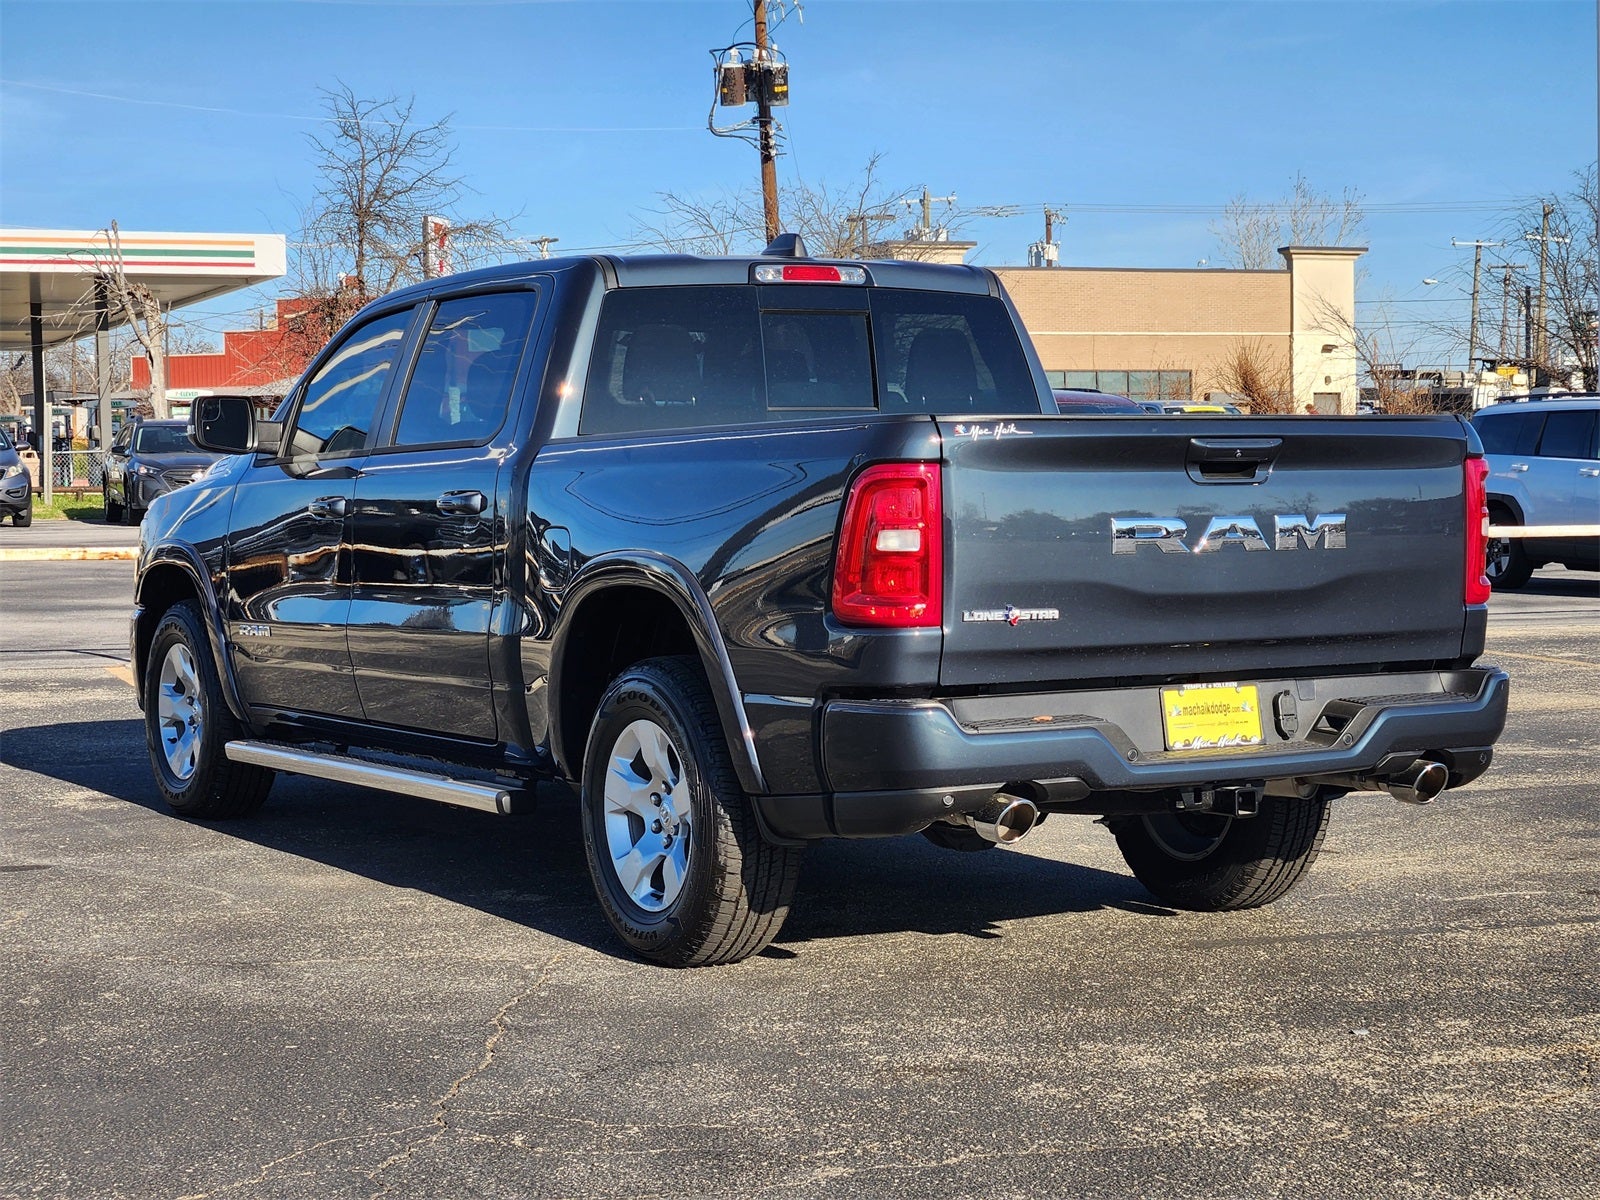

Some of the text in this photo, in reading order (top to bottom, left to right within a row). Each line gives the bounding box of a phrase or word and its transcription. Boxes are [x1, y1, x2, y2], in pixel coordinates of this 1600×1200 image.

[994, 422, 1027, 440] Haik
[1110, 513, 1347, 555] RAM
[962, 609, 1060, 622] LONE STAR
[239, 624, 272, 637] RAM
